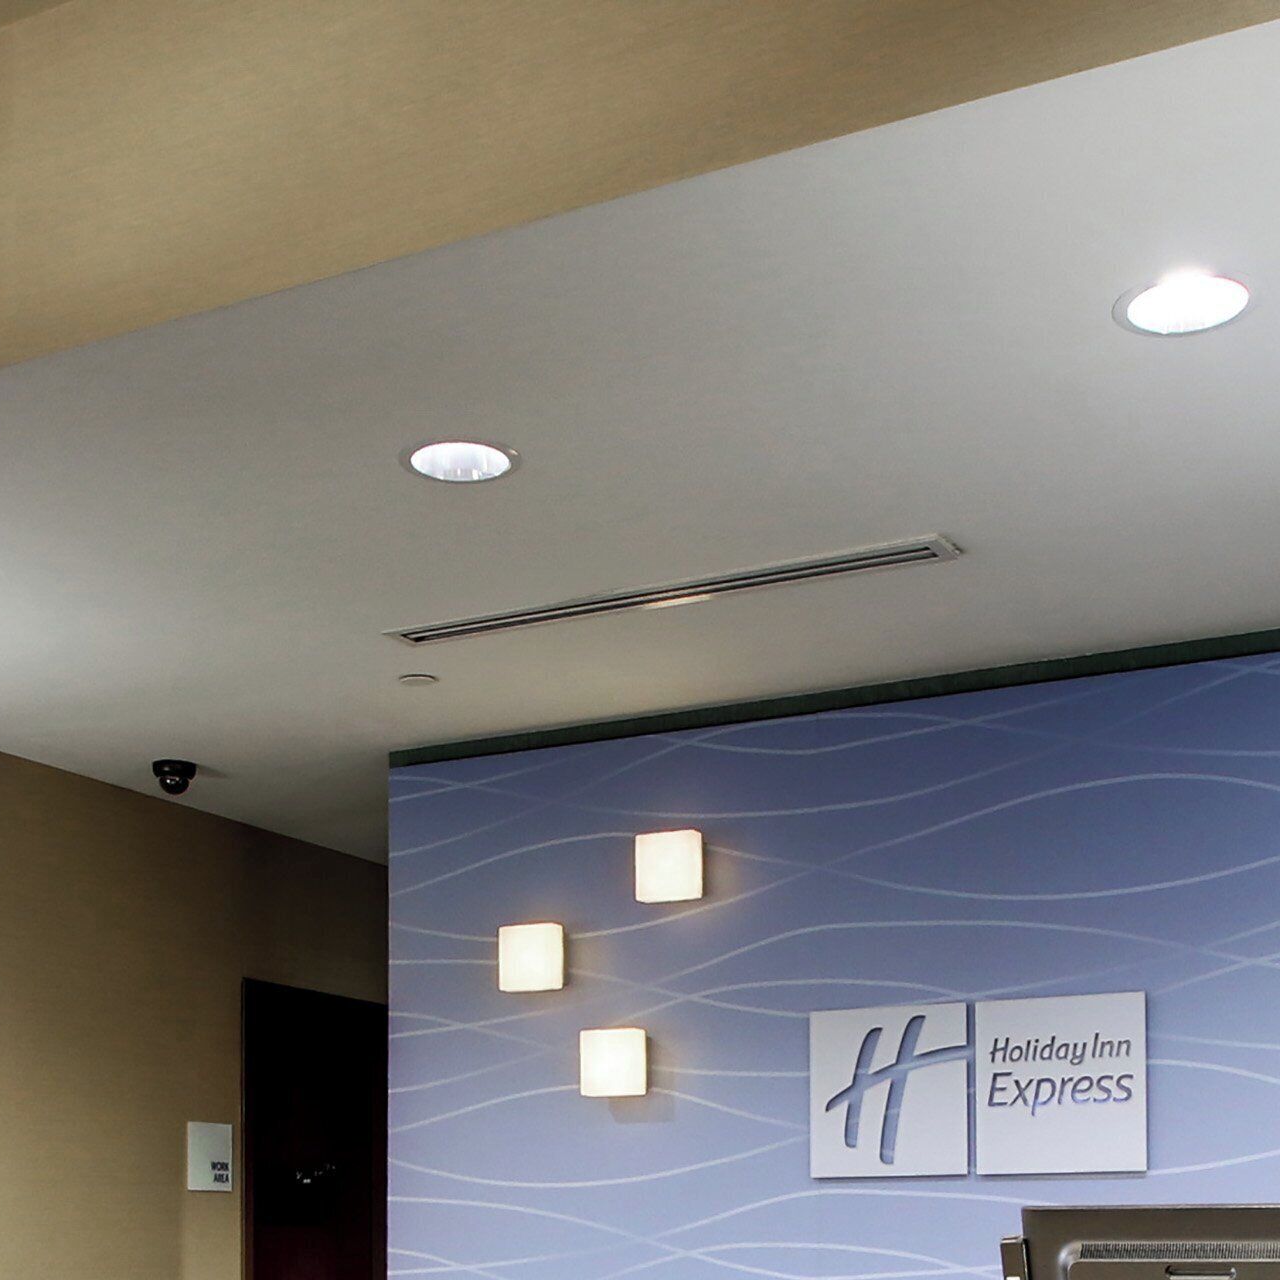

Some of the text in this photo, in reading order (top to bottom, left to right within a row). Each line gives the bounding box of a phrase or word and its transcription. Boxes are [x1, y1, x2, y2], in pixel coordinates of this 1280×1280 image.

[989, 1032, 1131, 1066] Holiday Inn
[987, 1071, 1134, 1117] Express
[211, 1161, 229, 1171] WORK
[214, 1173, 229, 1183] AREA
